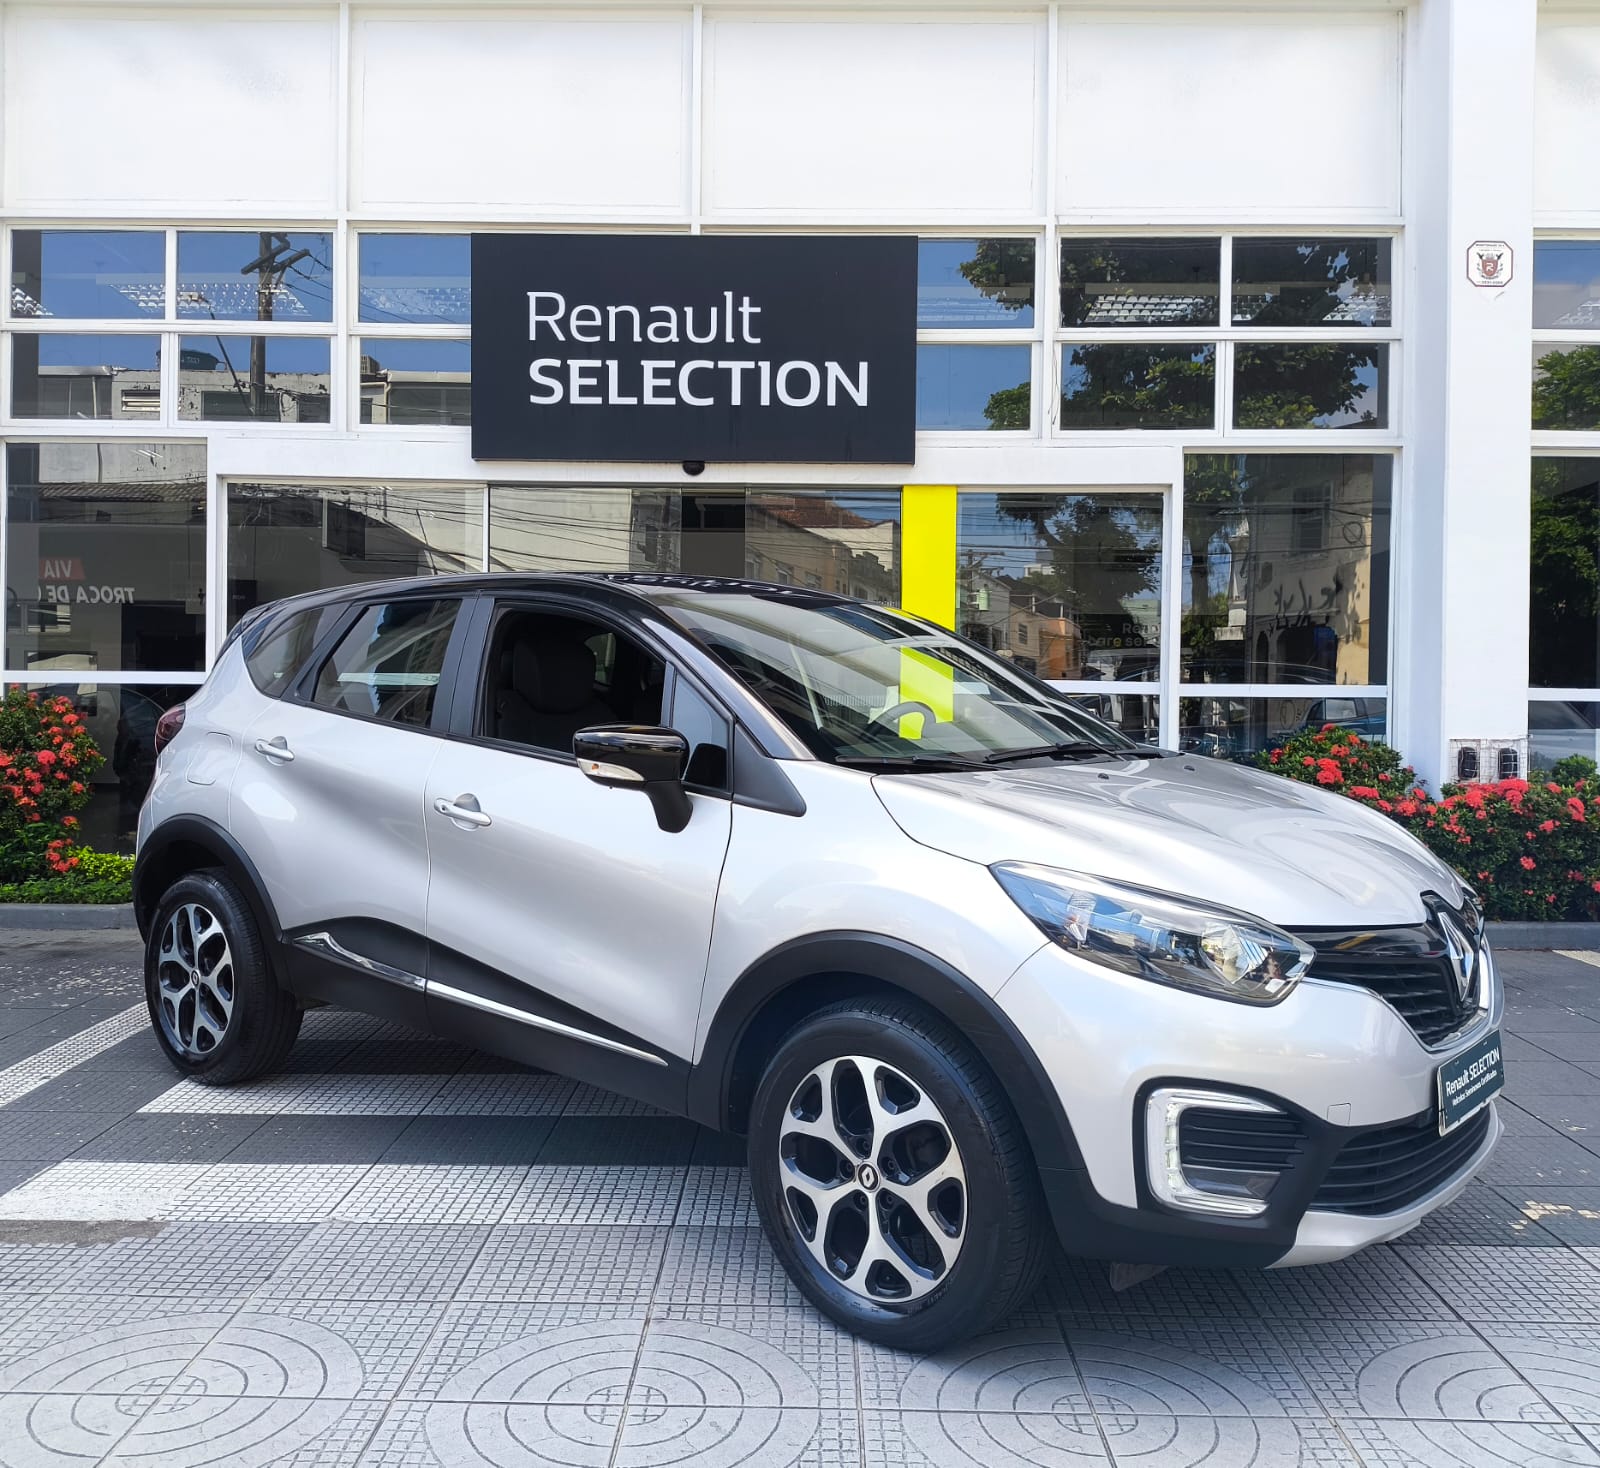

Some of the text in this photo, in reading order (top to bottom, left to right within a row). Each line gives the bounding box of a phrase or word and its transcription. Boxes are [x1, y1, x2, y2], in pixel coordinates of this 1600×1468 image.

[526, 291, 762, 343] Renault
[528, 358, 868, 407] SELECTION
[1446, 1046, 1500, 1096] Renault SELECTION
